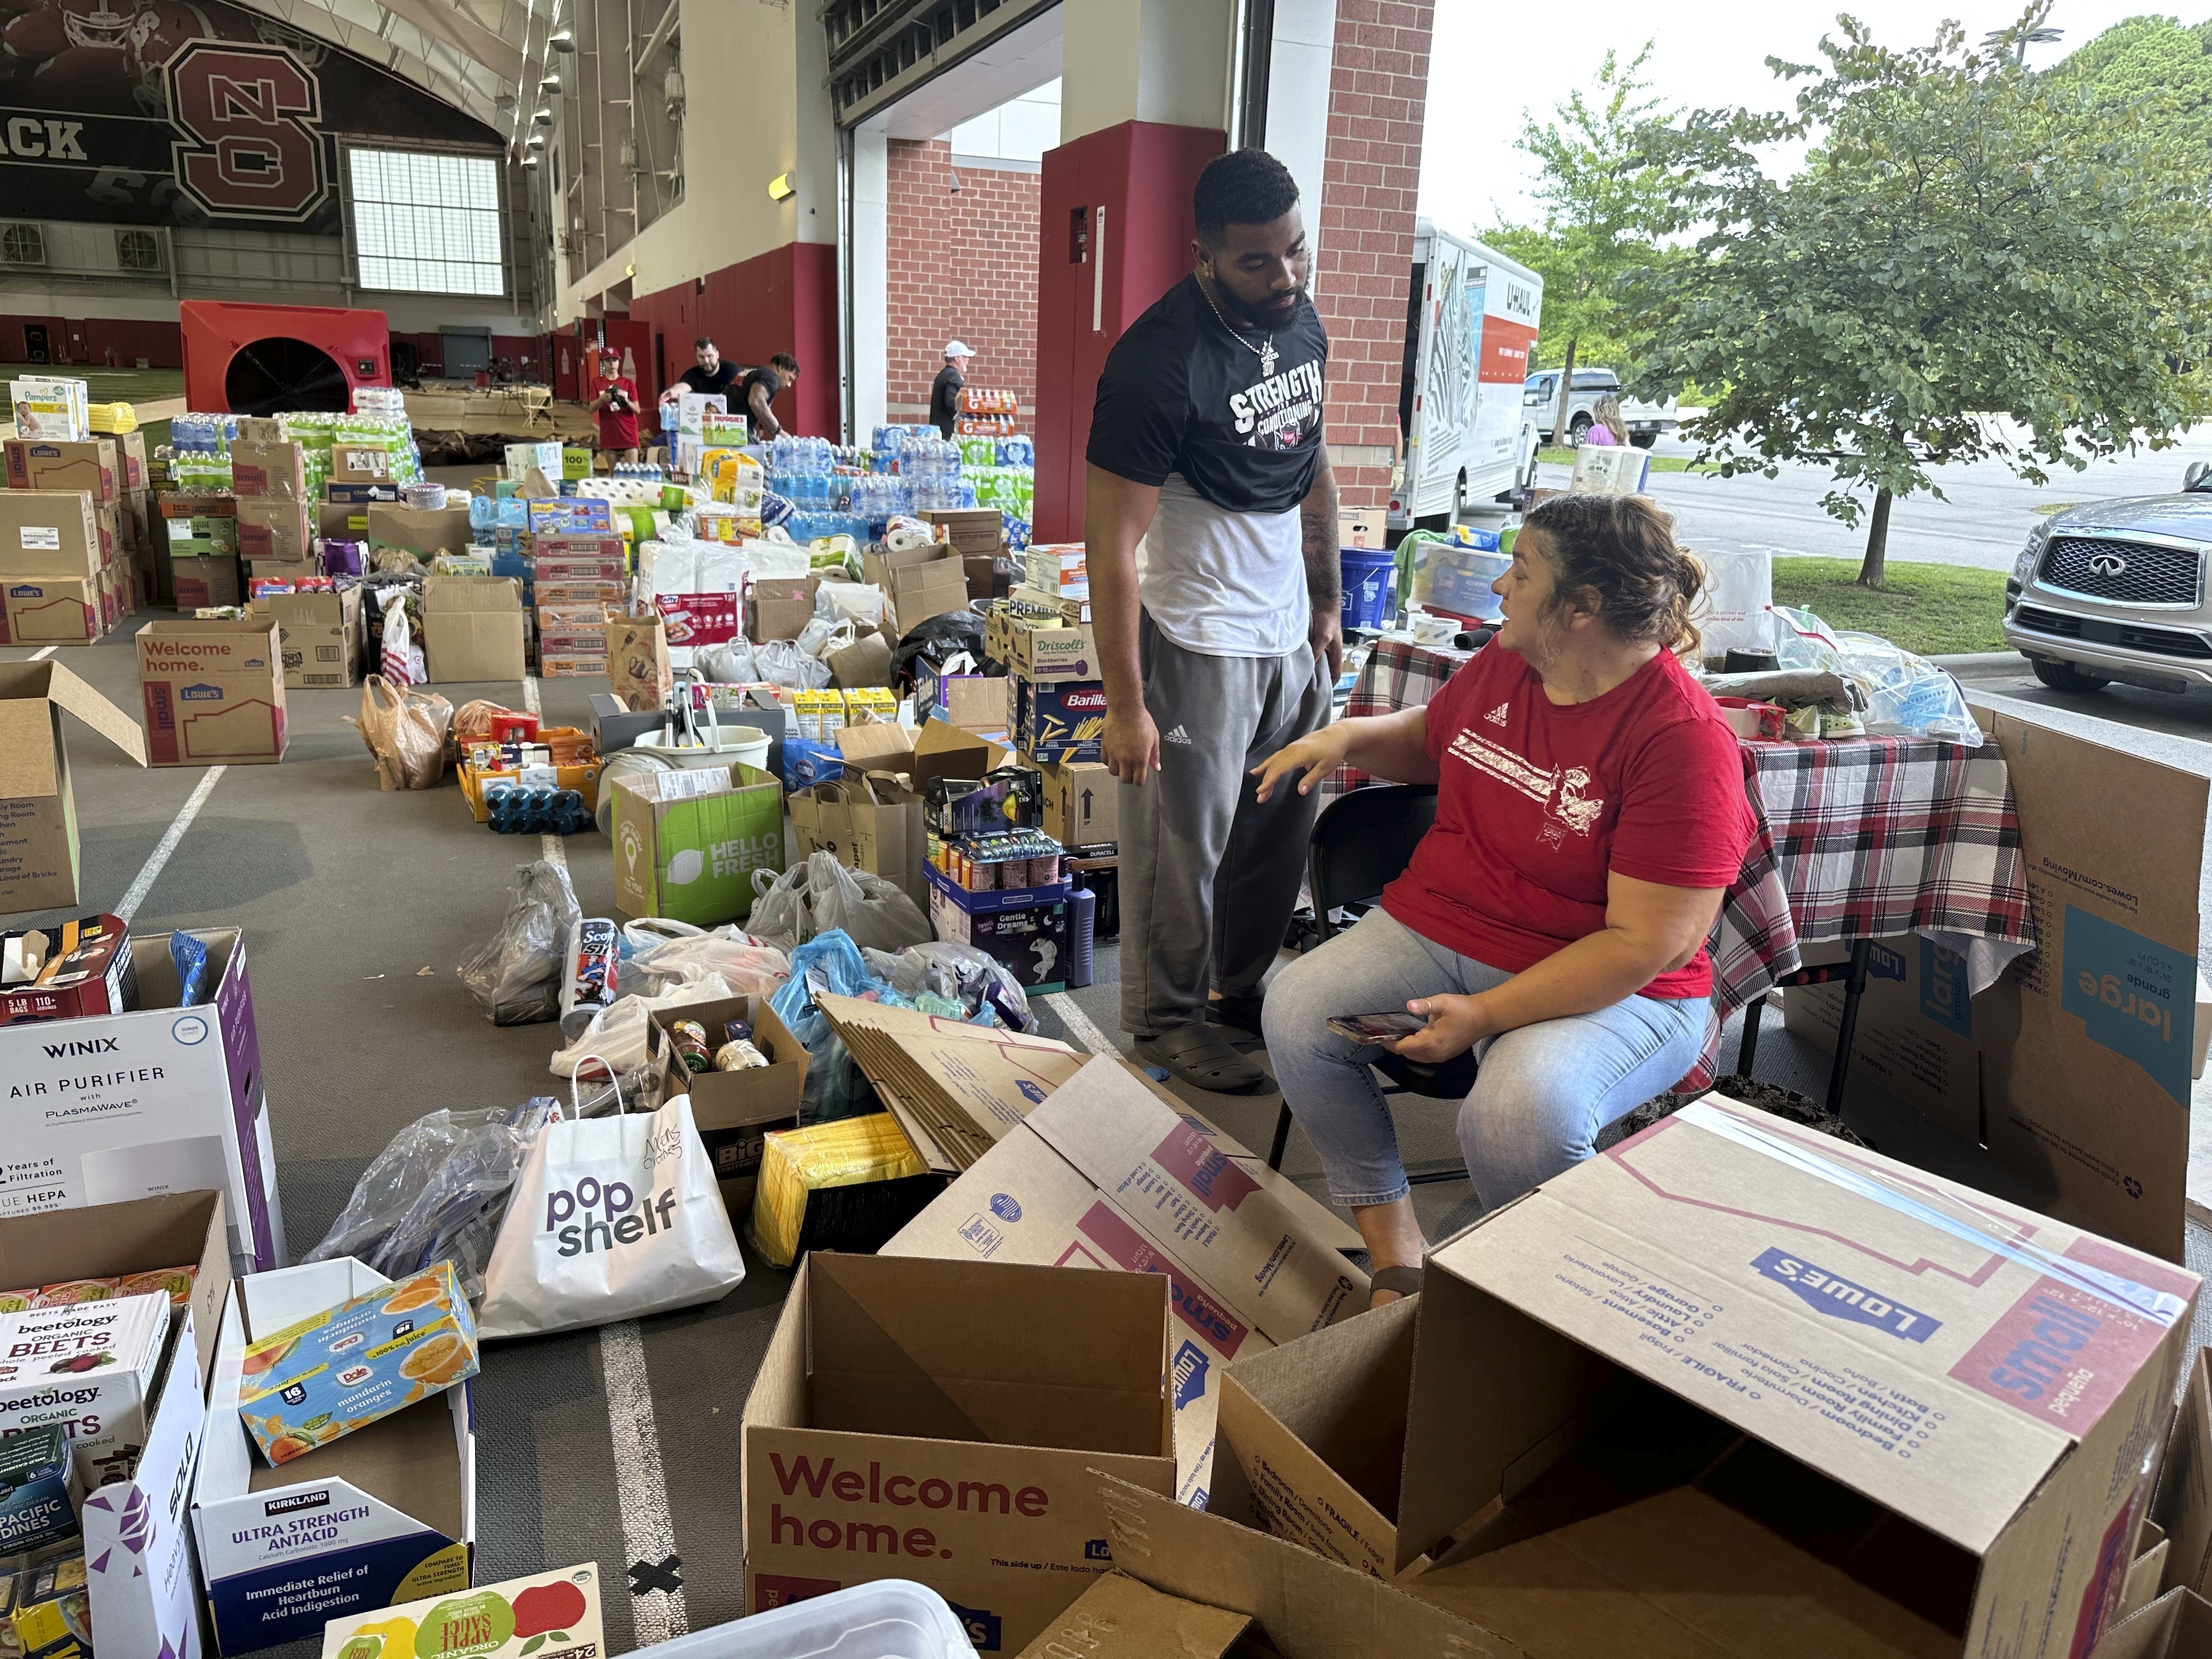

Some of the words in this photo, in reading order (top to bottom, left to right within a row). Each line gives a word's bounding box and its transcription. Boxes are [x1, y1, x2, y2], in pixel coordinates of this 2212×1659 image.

[25, 391, 57, 402] Pampers
[968, 399, 979, 410] G
[1229, 359, 1322, 435] STRENGTH
[963, 422, 973, 433] G
[1257, 399, 1312, 436] CONDITIONING
[11, 446, 26, 477] small
[564, 456, 589, 464] 100%
[236, 473, 262, 482] small
[143, 641, 232, 656] Welcome
[1037, 639, 1085, 652] Driscoll's
[146, 658, 205, 672] home.
[185, 689, 219, 699] LOWE'S
[1067, 694, 1107, 707] Barilla
[155, 687, 174, 730] small
[1164, 735, 1192, 744] adidas
[710, 832, 778, 861] HELLO
[713, 849, 779, 878] FRESH
[625, 877, 631, 888] TO
[2042, 857, 2138, 906] Lowes.com/Moving
[2096, 891, 2111, 903] make
[977, 920, 994, 928] Parent's
[997, 920, 1028, 929] Dreams
[999, 913, 1026, 922] Gentle
[2146, 954, 2159, 966] CU
[1951, 977, 1962, 1020] grande
[2126, 974, 2170, 1000] grande
[10, 1005, 29, 1014] BAGS
[35, 996, 57, 1007] 110+
[2078, 972, 2171, 1043] large
[41, 1037, 121, 1059] WINIX
[1860, 1053, 1887, 1074] FRAGILE
[10, 1082, 47, 1099] AIR
[59, 1066, 166, 1092] PURIFIER
[1911, 1069, 1941, 1093] Bedroom
[80, 1092, 101, 1101] with
[2061, 1140, 2082, 1156] better
[2083, 1151, 2100, 1166] even
[7, 1160, 39, 1173] Years
[42, 1157, 54, 1167] of
[9, 1168, 63, 1184] Filtration
[1190, 1153, 1227, 1198] small
[2067, 1153, 2100, 1176] awesome
[2100, 1161, 2119, 1177] Feels
[1116, 1180, 1128, 1194] Bricks
[1136, 1171, 1151, 1186] Garage
[1142, 1178, 1158, 1194] Laundry
[2100, 1171, 2119, 1187] Feels
[27, 1189, 66, 1204] HEPA
[546, 1176, 634, 1232] pop
[1155, 1190, 1172, 1210] Basement
[557, 1187, 677, 1257] shelf
[1172, 1204, 1188, 1219] Kitchen
[1201, 1229, 1216, 1248] FRAGILE
[1255, 1234, 1292, 1283] Lowes.com/Moving
[1562, 1253, 1625, 1290] Lavandería
[1601, 1261, 1639, 1283] Garaje
[1632, 1286, 1692, 1322] Laundry
[1646, 1284, 1700, 1313] Garage
[1773, 1257, 1918, 1333] LOWE'S
[30, 1310, 59, 1318] BEETS
[93, 1302, 118, 1311] EASY
[1196, 1294, 1238, 1331] pequeña
[1601, 1297, 1679, 1338] Basement
[1646, 1306, 1683, 1329] Attic
[18, 1312, 119, 1336] beetology
[318, 1313, 376, 1344] mandarin
[322, 1310, 373, 1334] oranges
[9, 1331, 111, 1358] BEETS
[31, 1329, 94, 1342] ORGANIC
[376, 1345, 395, 1356] 100%
[406, 1330, 426, 1346] juice
[1638, 1334, 1674, 1356] Frágil
[32, 1351, 71, 1362] peeled
[76, 1343, 116, 1355] cooked
[1989, 1295, 2102, 1400] small
[1739, 1342, 1802, 1379] Comedor
[1798, 1358, 1846, 1386] Cocina
[343, 1367, 368, 1383] Dole
[1680, 1355, 1748, 1393] FRAGILE
[1842, 1367, 1877, 1390] Baño
[284, 1386, 302, 1400] 16
[337, 1378, 393, 1407] mandarin
[1740, 1368, 1809, 1409] Dormitorio
[1810, 1378, 1857, 1404] Room
[2046, 1367, 2095, 1417] pequeña
[346, 1389, 392, 1414] oranges
[1852, 1381, 1922, 1424] Kitchen
[1888, 1388, 1931, 1414] Bath
[20, 1408, 78, 1425] ORGANIC
[1860, 1400, 1913, 1434] Dining
[1819, 1407, 1895, 1452] Bedroom
[76, 1436, 115, 1451] cooked
[29, 1472, 36, 1481] 6
[169, 1433, 194, 1523] SOLO
[769, 1452, 1049, 1518] Welcome
[1261, 1460, 1294, 1496] Bedroom
[9, 1496, 34, 1505] CAUGHT
[26, 1496, 50, 1506] OCEAN
[268, 1492, 327, 1510] KIRKLAND
[1260, 1474, 1284, 1502] Family
[1284, 1495, 1306, 1523] Room
[0, 1499, 61, 1528] PACIFIC
[232, 1523, 284, 1544] ULTRA
[289, 1505, 370, 1532] STRENGTH
[1325, 1505, 1359, 1540] FRAGILE
[25, 1534, 42, 1543] OLIVE
[268, 1526, 338, 1551] ANTACID
[770, 1504, 953, 1560] home.
[258, 1550, 284, 1560] Calcium
[285, 1543, 319, 1555] Carbonate
[337, 1537, 349, 1545] mg
[425, 1557, 454, 1568] COMPARE
[990, 1558, 1009, 1568] This
[1011, 1561, 1029, 1569] side
[1030, 1562, 1042, 1571] up
[1050, 1564, 1069, 1572] Este
[1070, 1564, 1090, 1573] lado
[246, 1578, 315, 1601] Immediate
[318, 1567, 354, 1586] Relief
[356, 1564, 369, 1578] of
[411, 1573, 432, 1583] ULTRA
[433, 1566, 464, 1578] STRENGTH
[278, 1584, 341, 1606] Heartburn
[262, 1607, 289, 1622] Acid
[291, 1592, 360, 1615] Indigestion
[439, 1613, 492, 1638] SAUCE
[439, 1626, 492, 1652] APPLE
